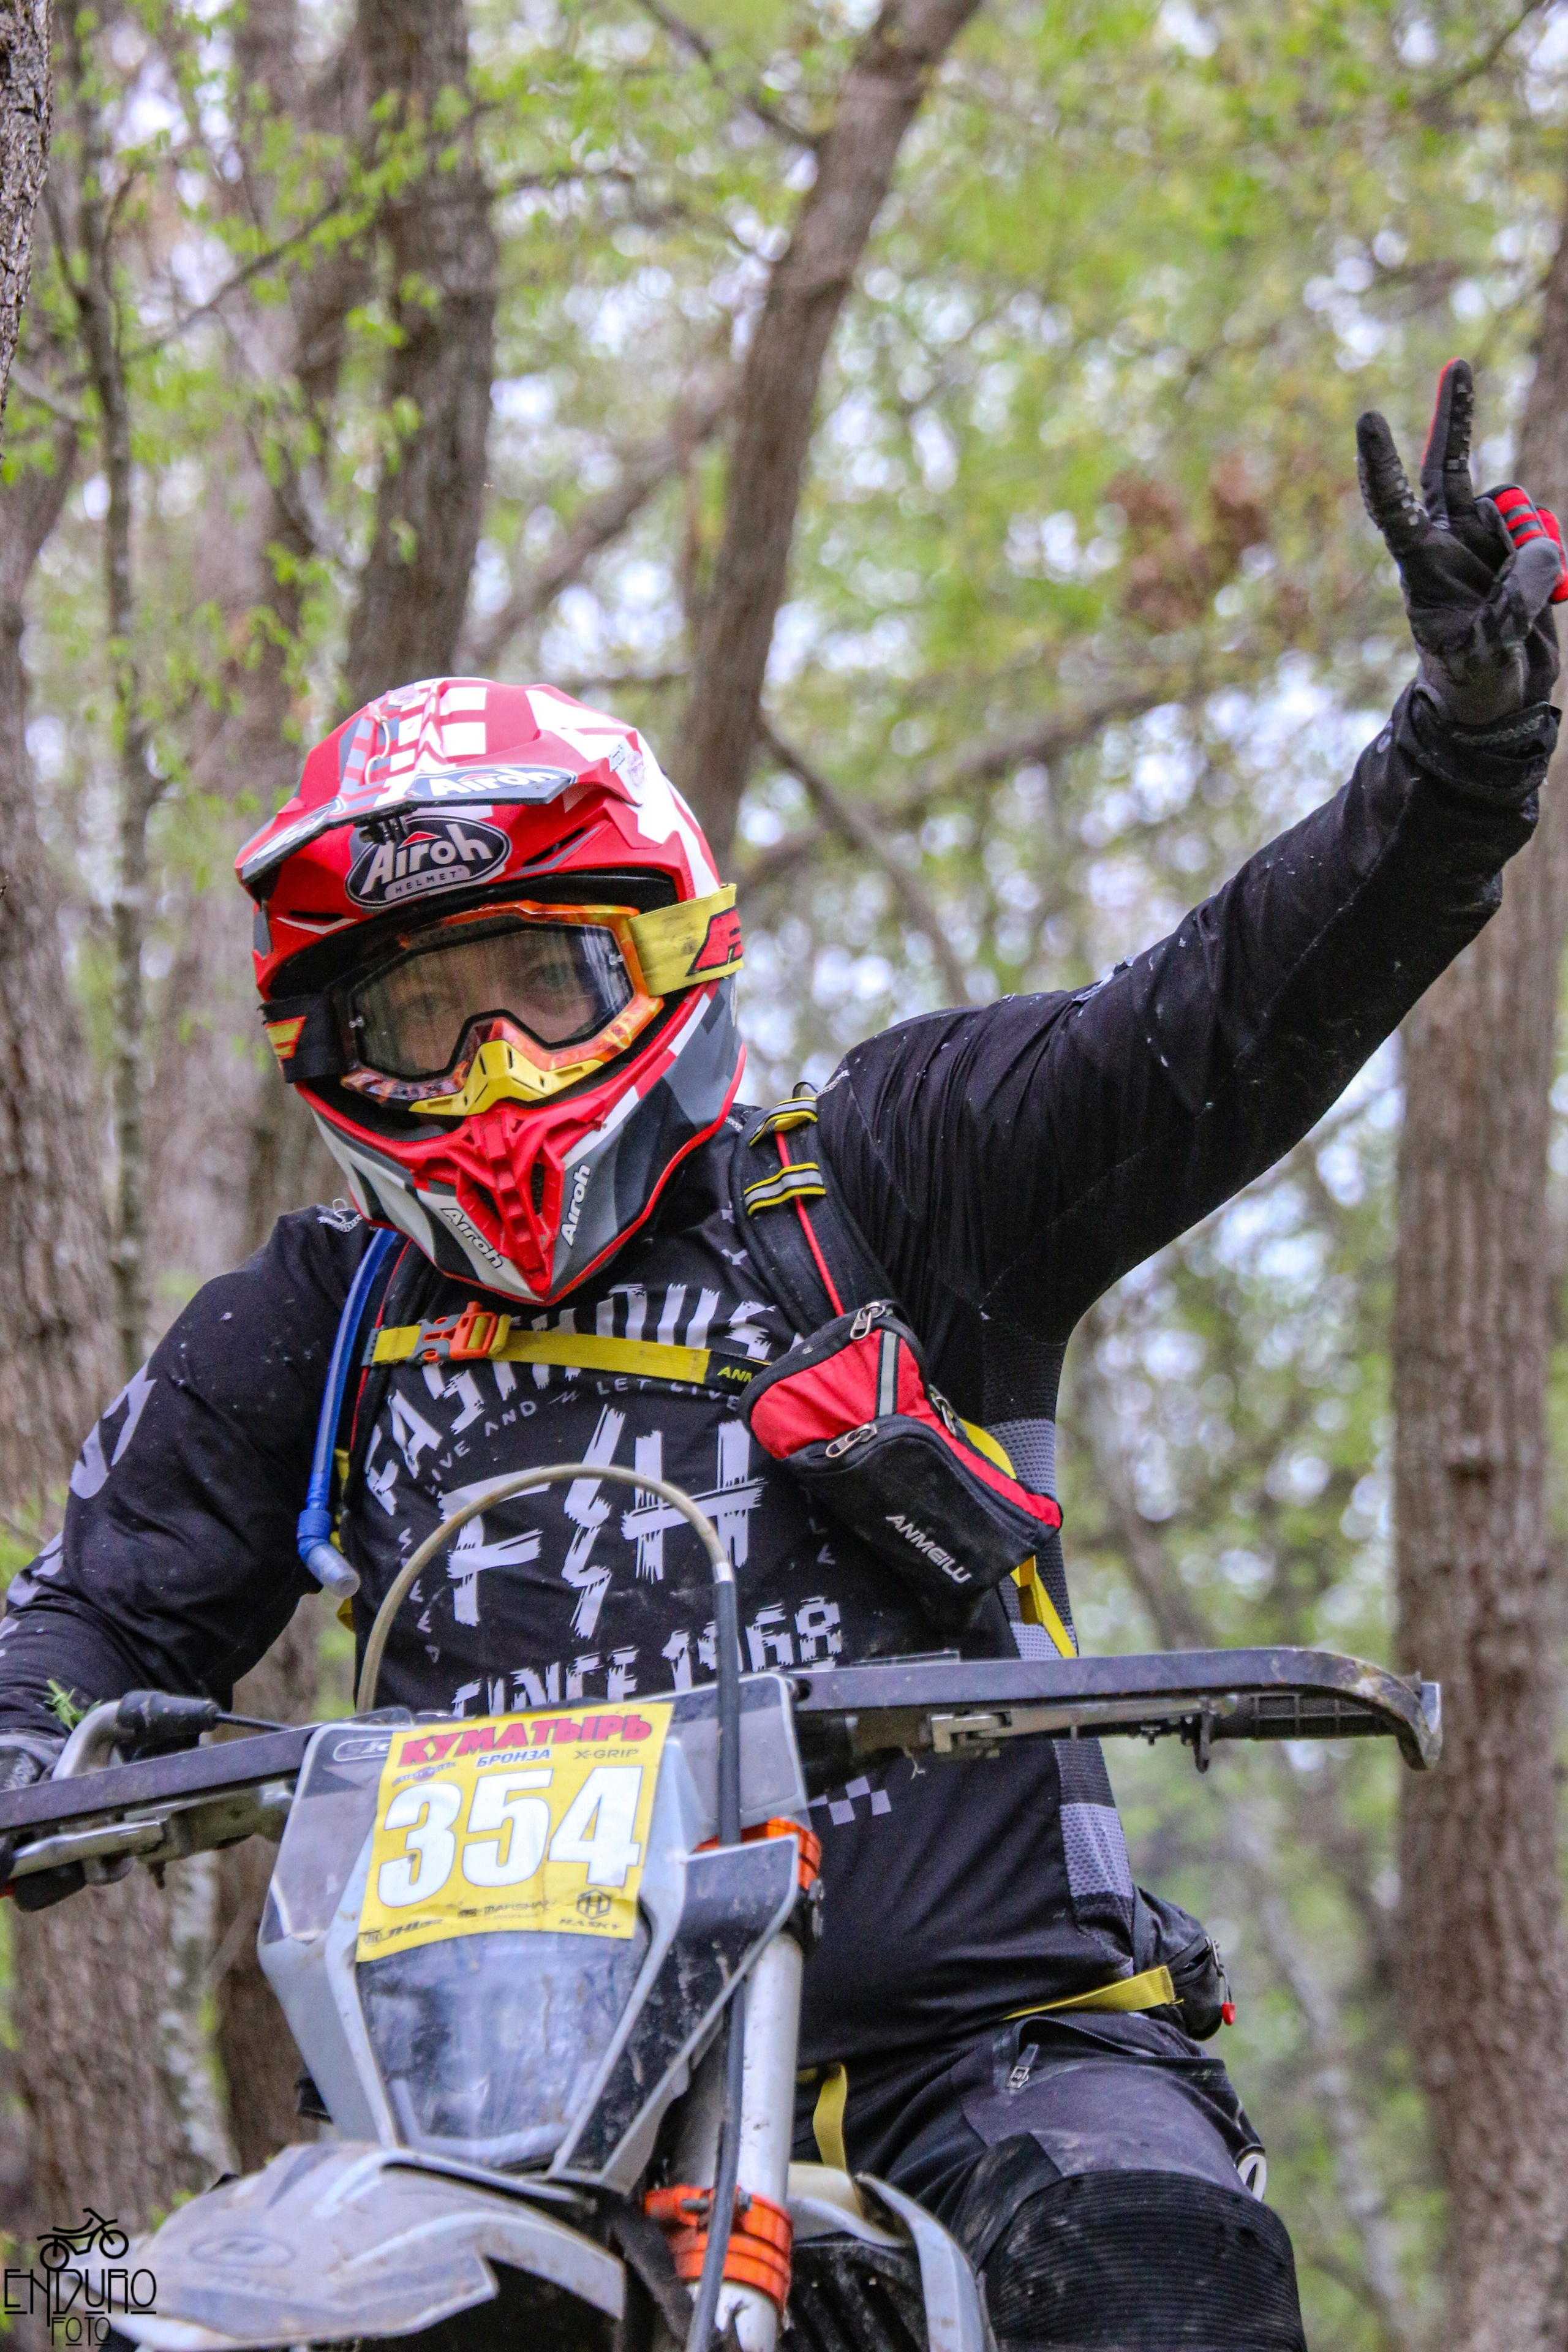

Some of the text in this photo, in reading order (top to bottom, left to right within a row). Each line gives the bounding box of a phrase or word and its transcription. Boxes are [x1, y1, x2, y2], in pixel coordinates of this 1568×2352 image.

[429, 767, 560, 796] Airoh
[359, 823, 494, 896] Airoh
[394, 870, 458, 894] HELMET
[560, 1163, 592, 1247] Airoh
[440, 1207, 503, 1270] Airoh
[484, 1400, 538, 1437] AND
[596, 1378, 652, 1396] LET
[885, 1513, 972, 1585] ANMEILU
[397, 1715, 652, 1768] КУМАТЫРЬ
[475, 1748, 551, 1769] БРОНЗА
[377, 1766, 643, 1909] 354
